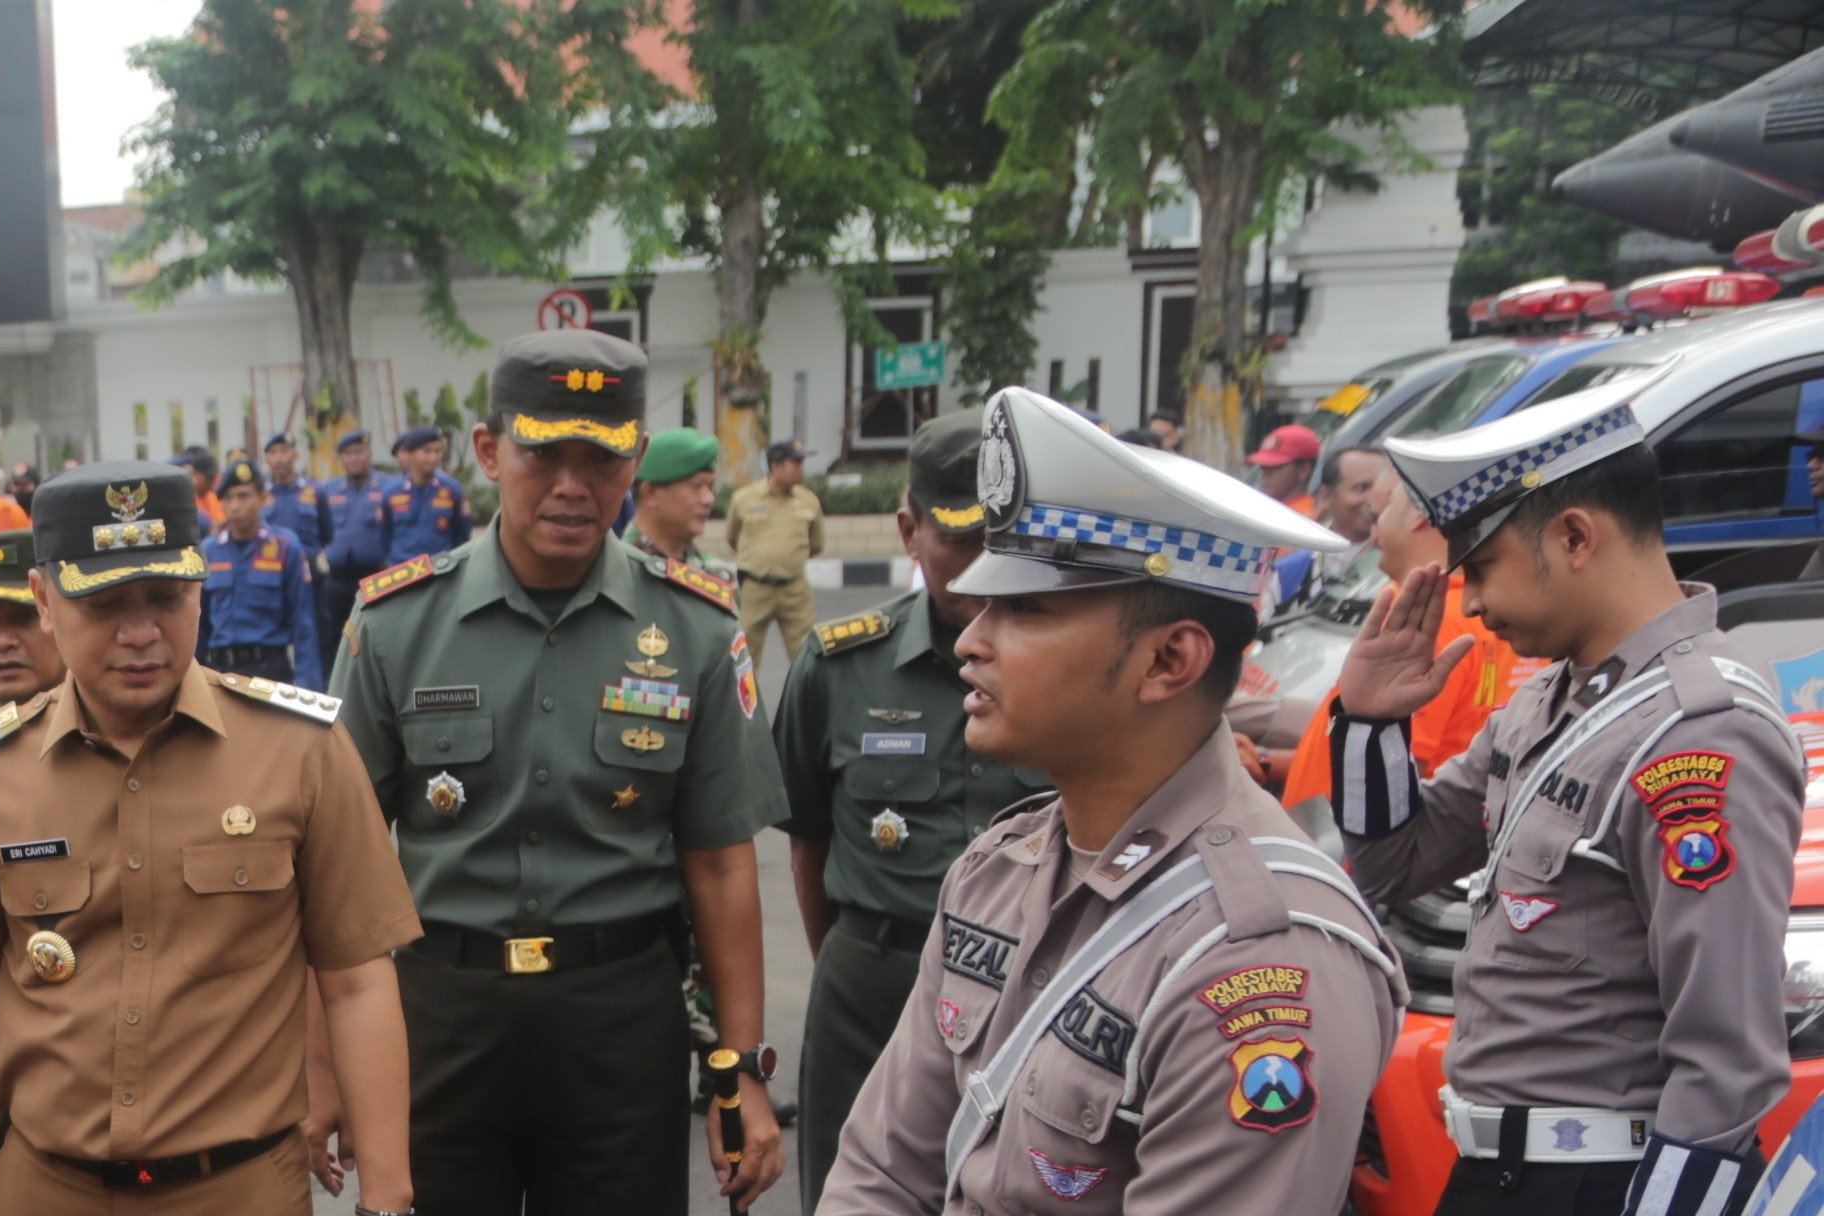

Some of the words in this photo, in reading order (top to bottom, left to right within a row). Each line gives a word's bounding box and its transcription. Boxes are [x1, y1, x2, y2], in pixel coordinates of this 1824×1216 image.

[417, 691, 475, 705] DHARMAWAN
[877, 739, 912, 749] ADNAN
[1636, 755, 1726, 789] POLRESTABES
[1646, 769, 1717, 795] SURABAYA
[10, 848, 24, 859] ERI
[25, 844, 57, 858] CAHYADI
[943, 921, 1010, 982] EYZAL
[1204, 967, 1304, 1004] POLRESTABES
[1217, 981, 1297, 1008] SURABAYA
[1062, 996, 1127, 1066] OLRI
[1226, 1011, 1265, 1034] JAWA
[1266, 1007, 1308, 1022] TIMUR
